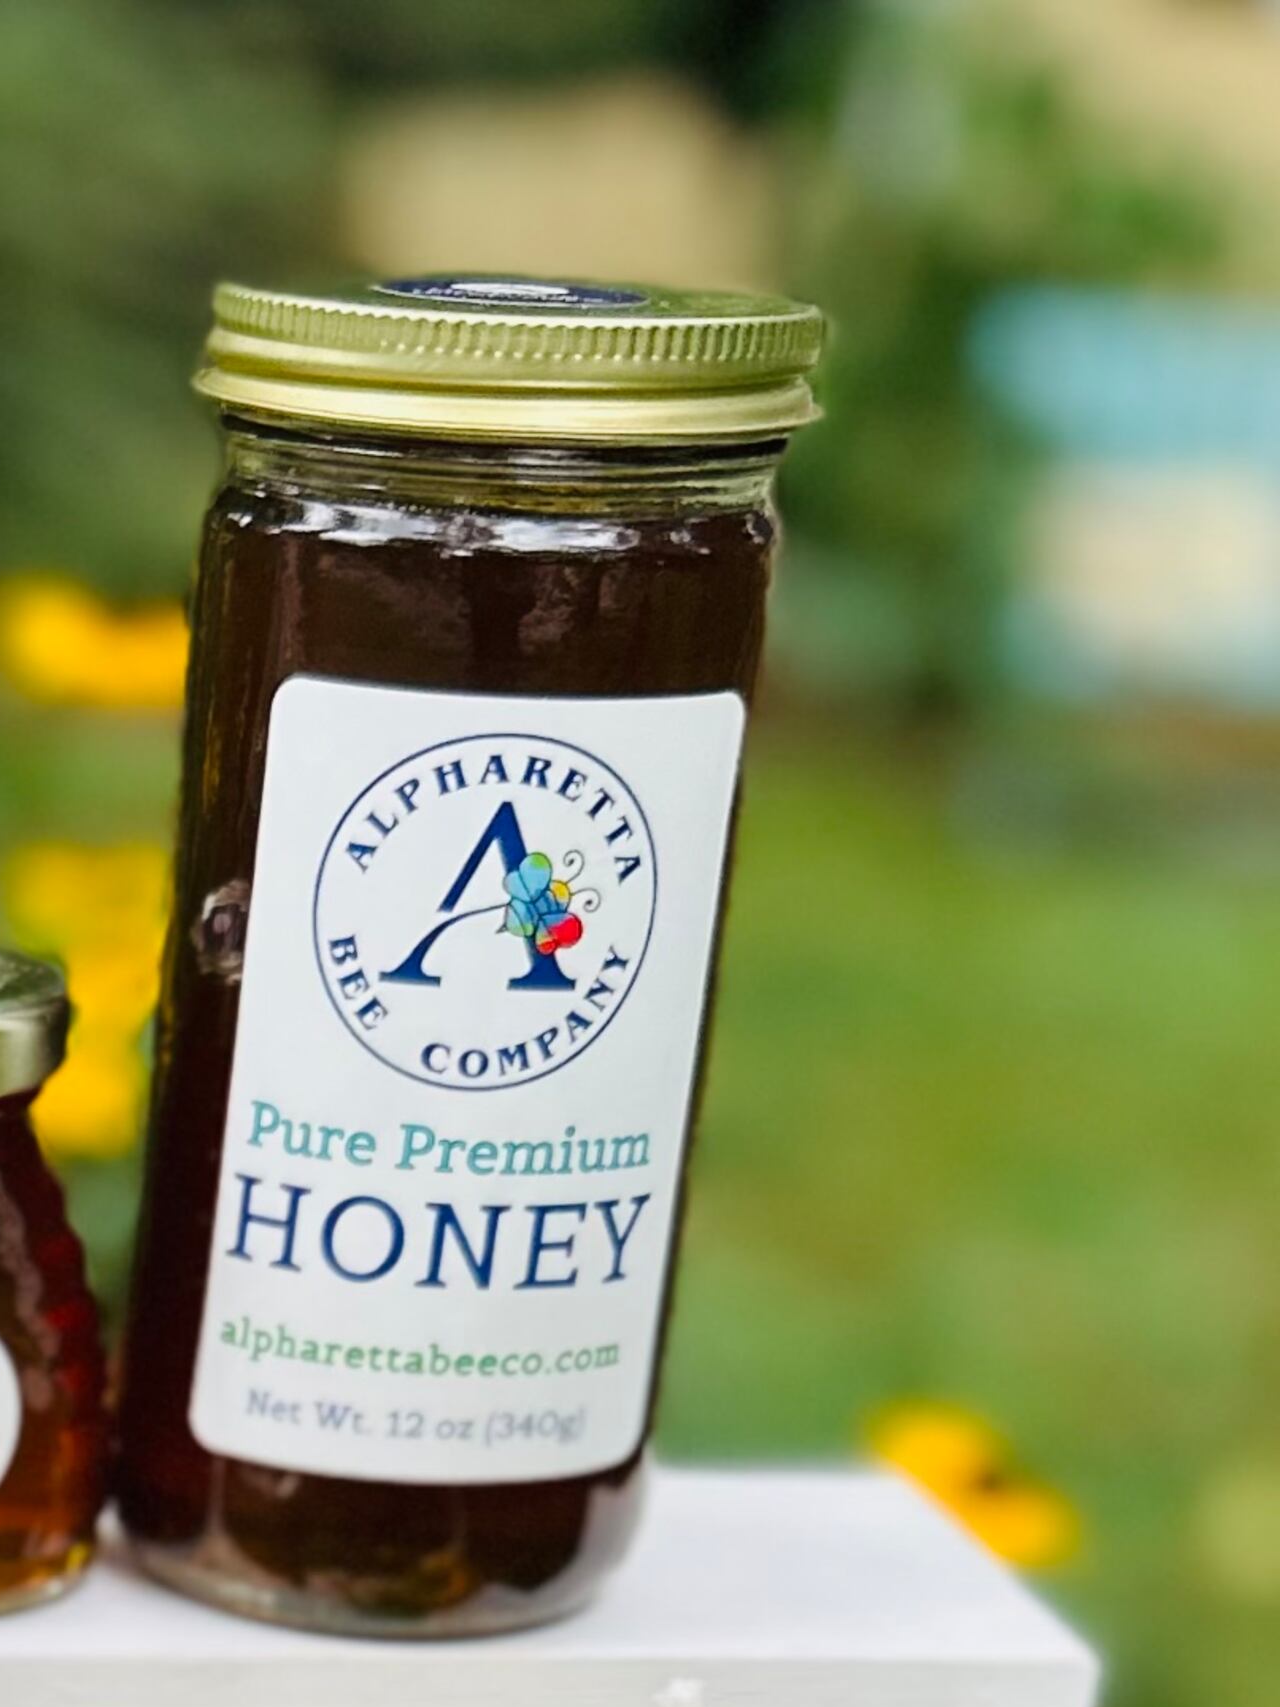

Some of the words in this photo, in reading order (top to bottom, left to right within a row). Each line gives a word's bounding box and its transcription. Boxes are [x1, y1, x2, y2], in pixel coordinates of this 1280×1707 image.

[346, 754, 641, 884] ALPHARETTA
[329, 935, 388, 1031] BEE
[421, 946, 629, 1078] COMPANY
[248, 1100, 376, 1166] Pure
[395, 1123, 651, 1175] Premium
[226, 1172, 651, 1290] HONEY
[220, 1316, 620, 1375] alpharettabeeco.com
[247, 1388, 301, 1423] Net
[387, 1411, 424, 1439] 12
[436, 1417, 474, 1441] oz
[485, 1408, 584, 1447] (340g)
